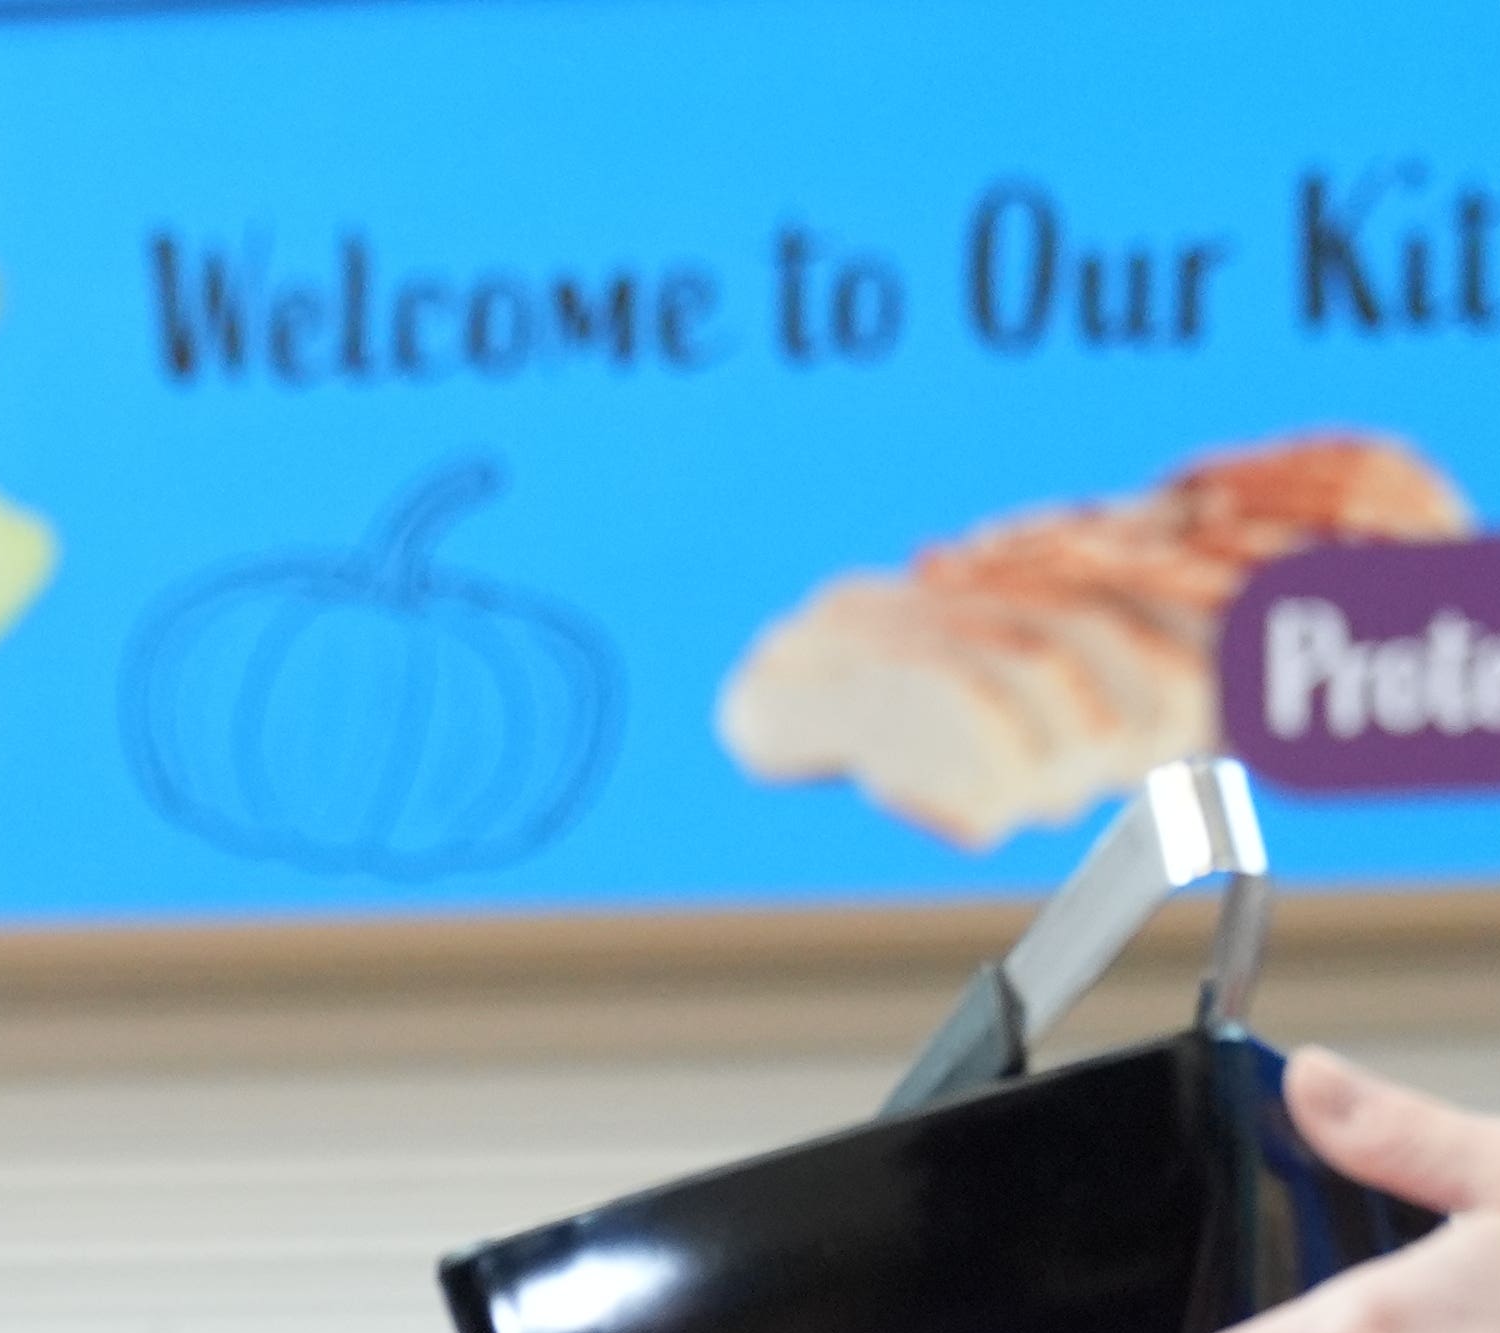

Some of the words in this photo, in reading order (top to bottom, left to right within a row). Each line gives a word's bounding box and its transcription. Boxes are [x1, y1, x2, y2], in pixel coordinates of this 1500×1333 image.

[148, 218, 730, 388] Welcome
[772, 222, 904, 368] to
[966, 180, 1236, 356] Our
